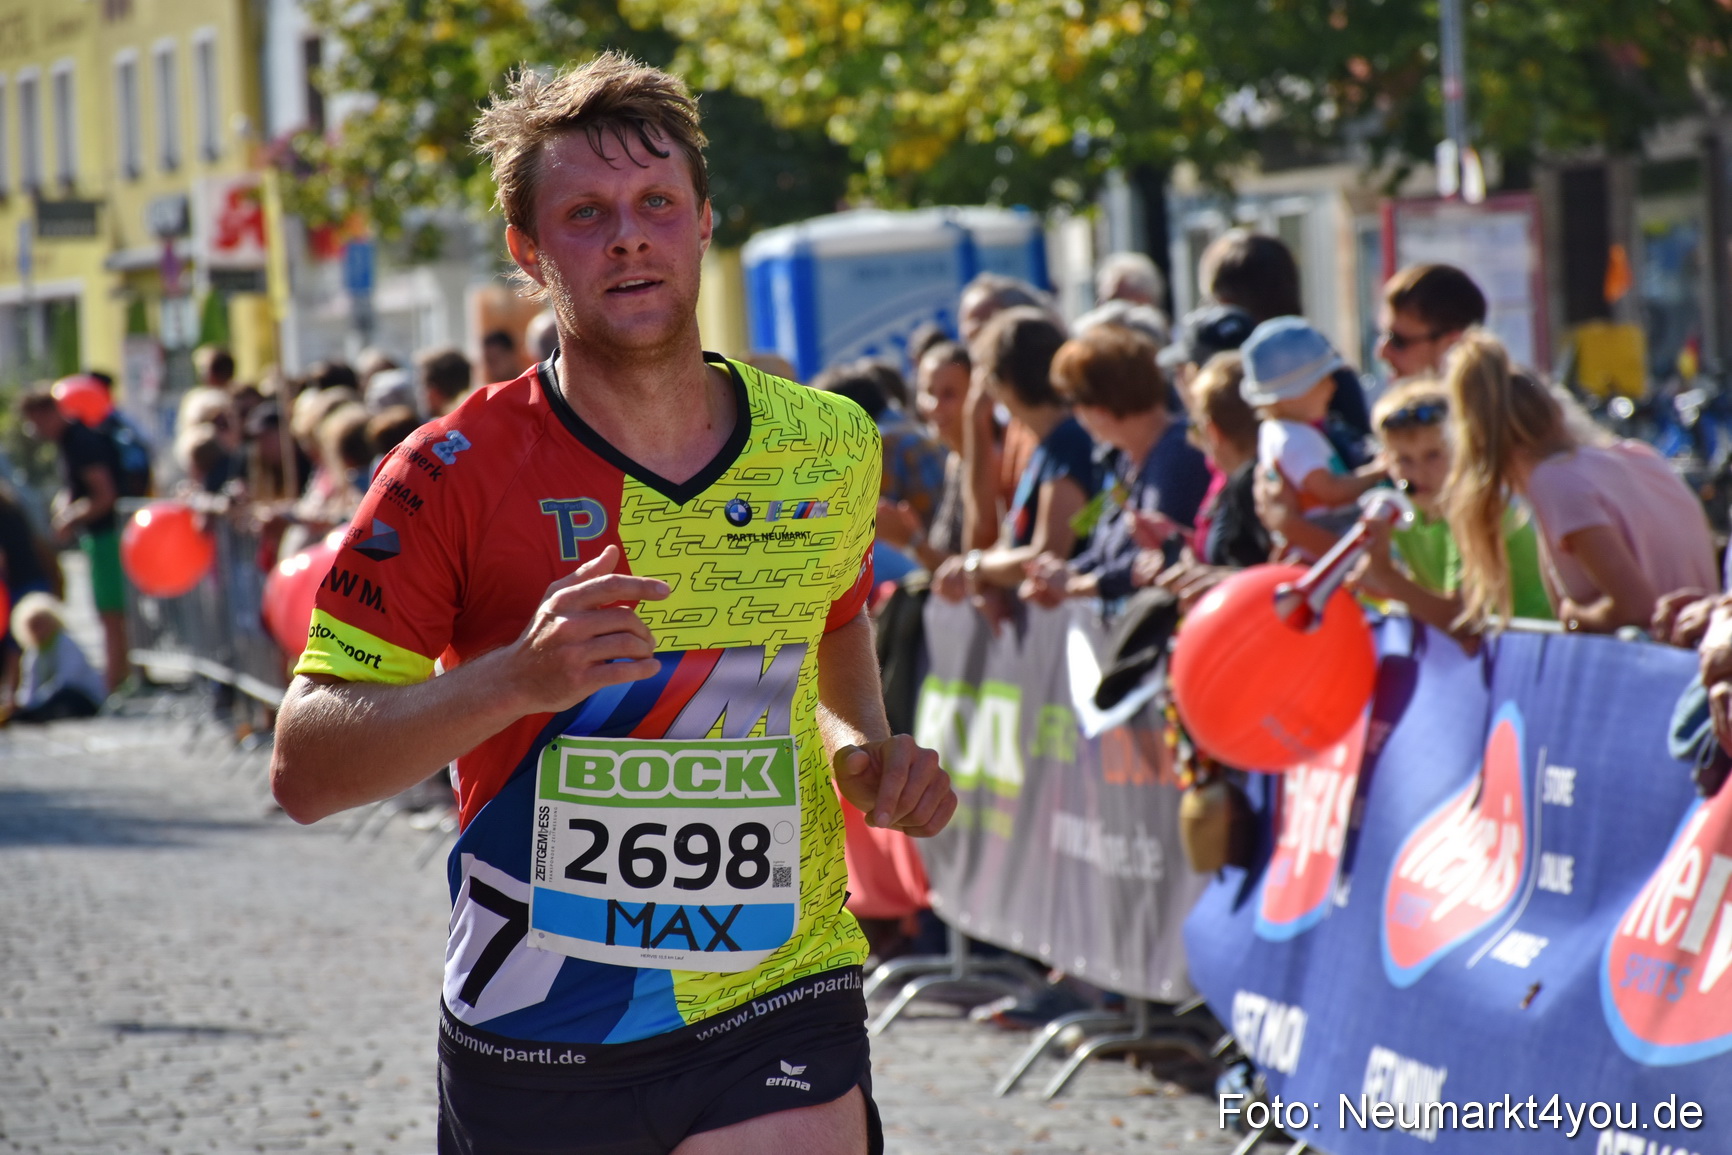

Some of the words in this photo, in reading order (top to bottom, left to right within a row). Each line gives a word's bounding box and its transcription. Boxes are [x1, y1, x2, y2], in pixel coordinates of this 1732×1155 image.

[726, 532, 760, 542] PARTL
[761, 530, 812, 542] NEUMARKT
[560, 749, 778, 798] BOCK
[564, 818, 771, 891] 2698
[458, 875, 530, 1009] 7
[605, 898, 744, 953] MAX
[765, 1076, 811, 1092] erima
